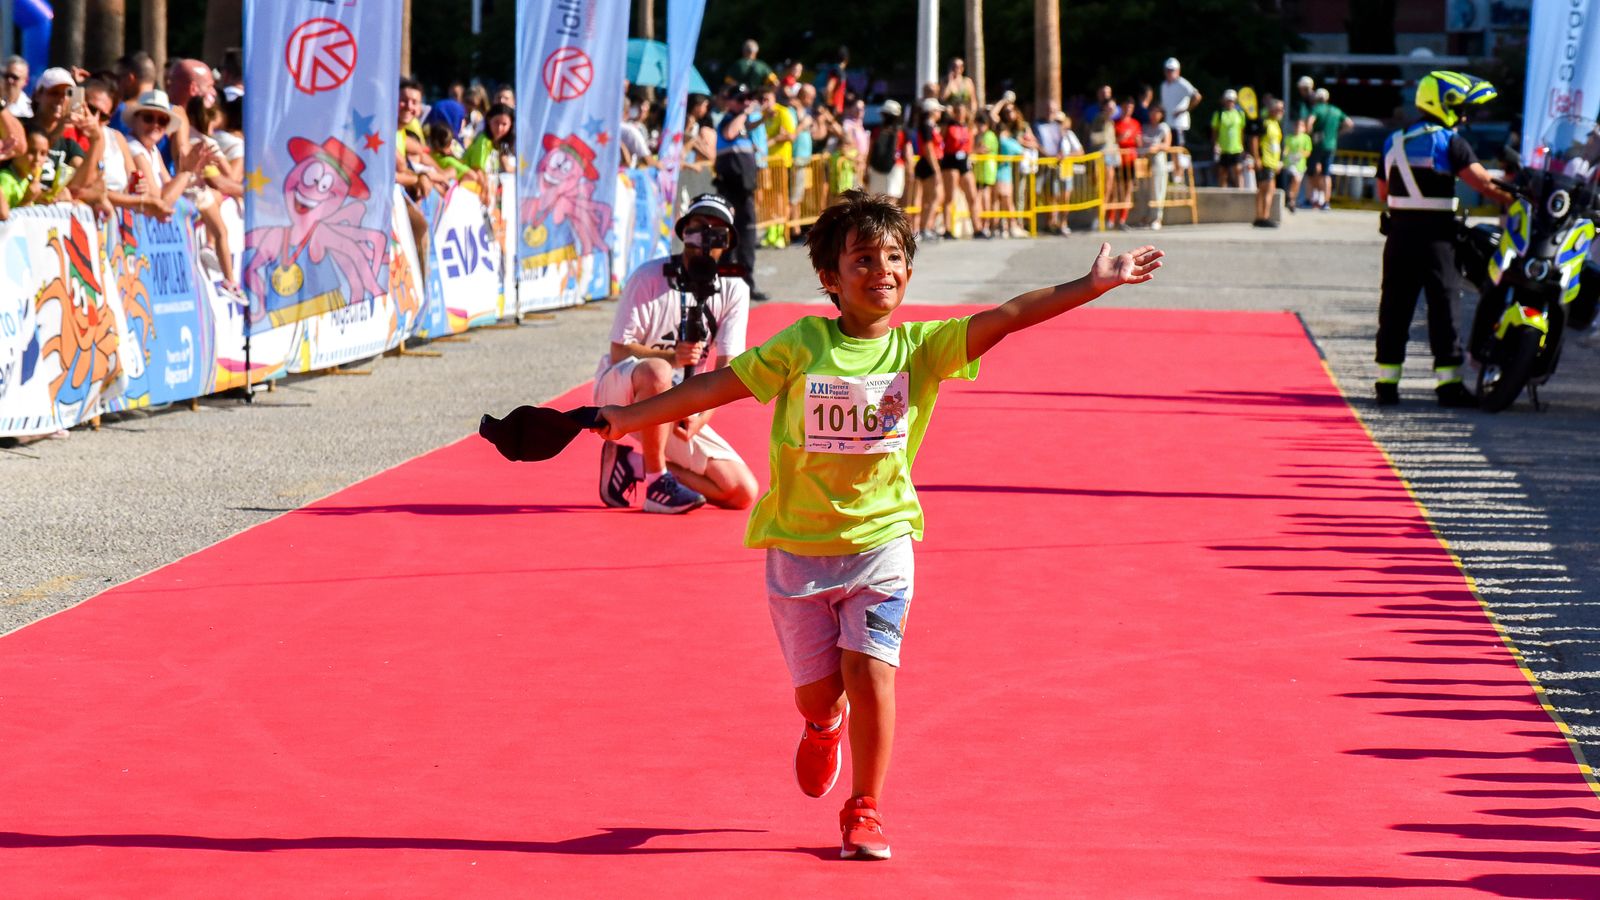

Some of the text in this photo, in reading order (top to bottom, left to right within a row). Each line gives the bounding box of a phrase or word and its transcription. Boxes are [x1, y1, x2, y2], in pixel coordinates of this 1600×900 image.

[810, 382, 829, 395] XXI
[829, 389, 849, 397] Popular
[813, 403, 878, 432] 1016
